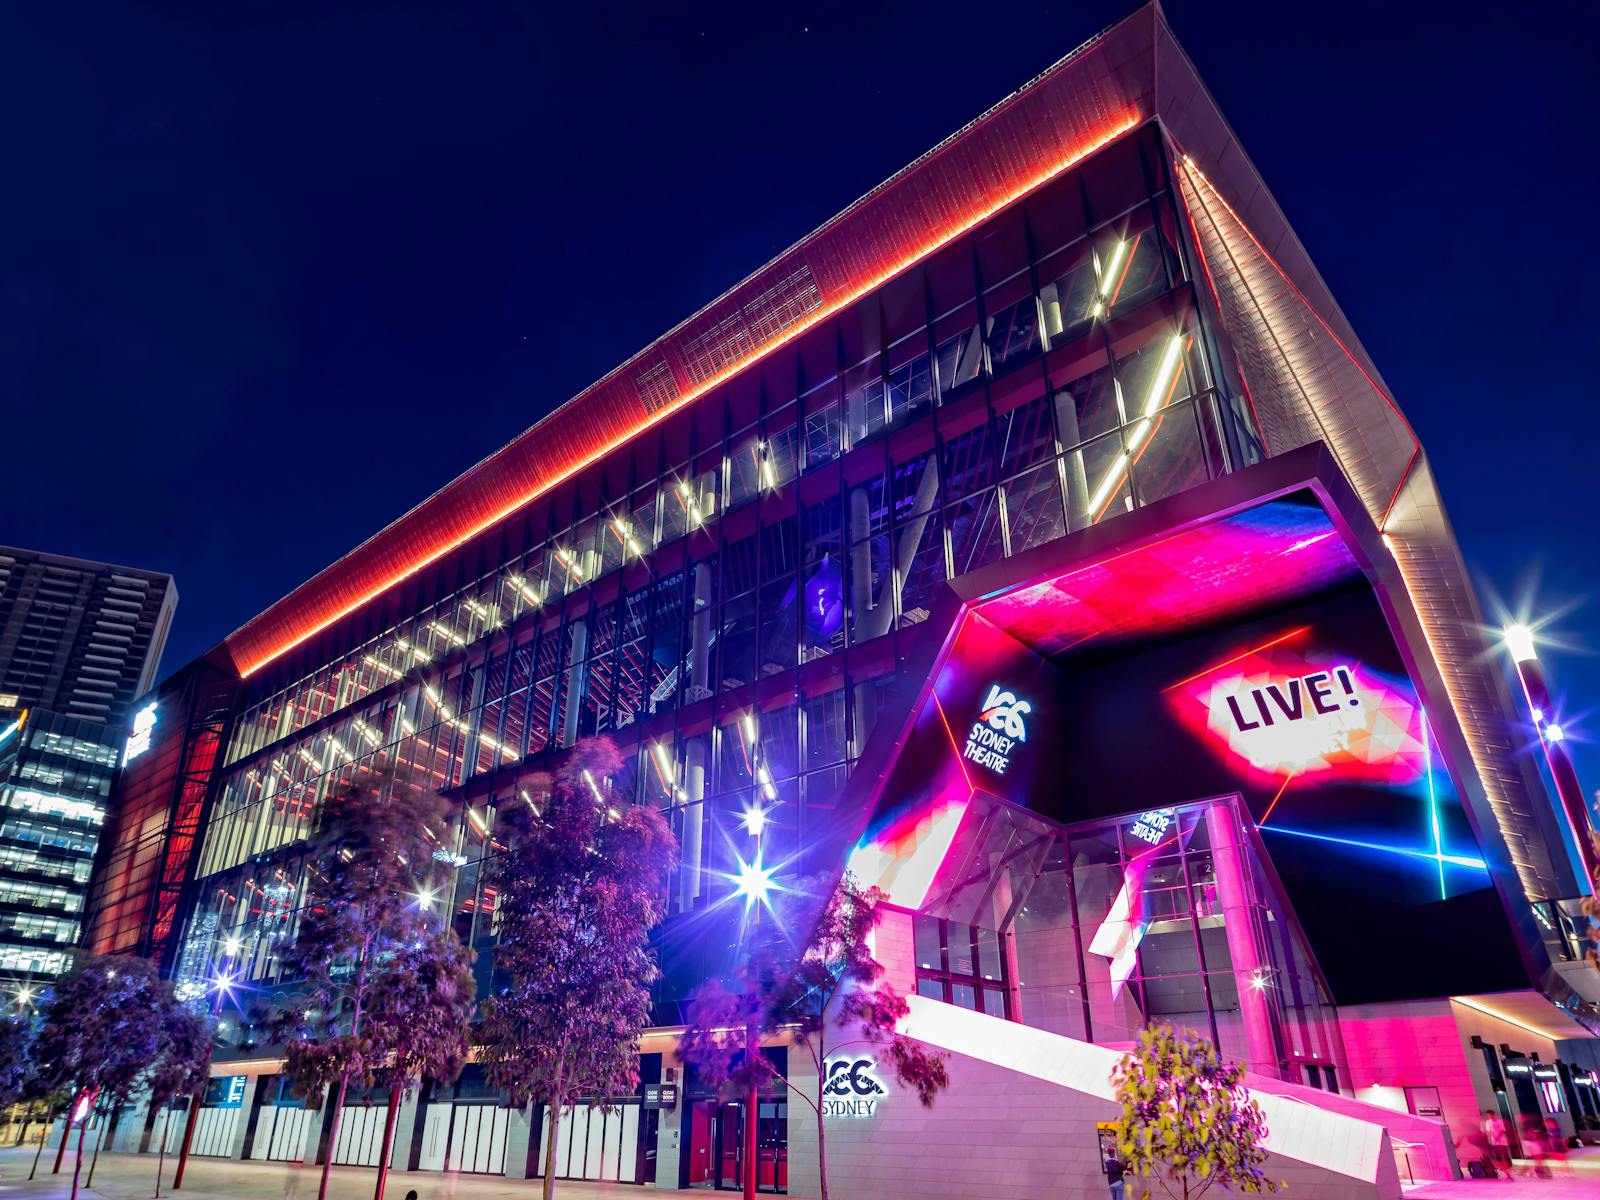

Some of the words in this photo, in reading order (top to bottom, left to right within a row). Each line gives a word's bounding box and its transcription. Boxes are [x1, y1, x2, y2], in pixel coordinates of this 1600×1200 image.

[1226, 669, 1359, 732] LIVE!
[969, 722, 1015, 755] SYDNEY
[963, 740, 1009, 774] THEATRE
[823, 1059, 884, 1096] ICC
[822, 1100, 873, 1115] SYDNEY
